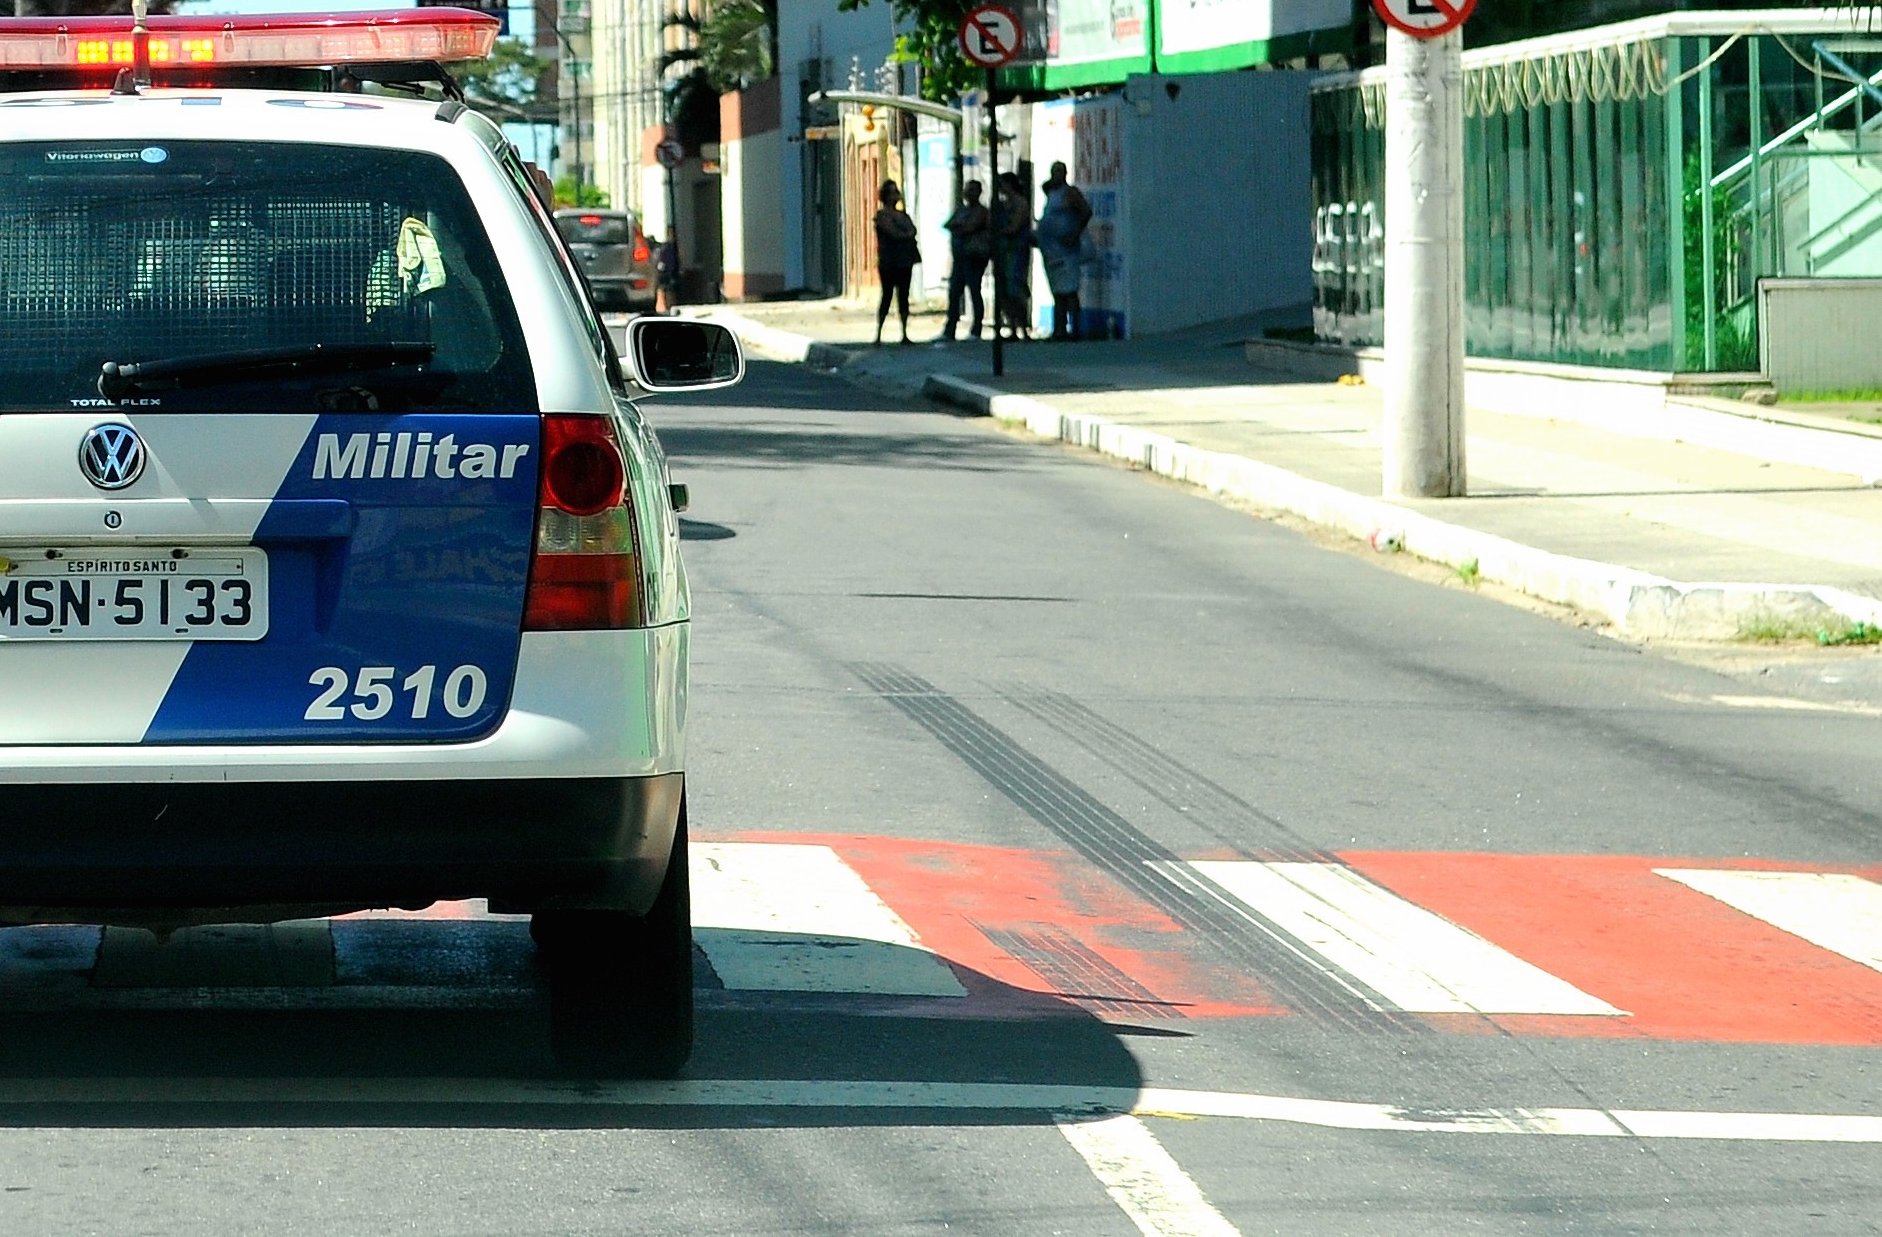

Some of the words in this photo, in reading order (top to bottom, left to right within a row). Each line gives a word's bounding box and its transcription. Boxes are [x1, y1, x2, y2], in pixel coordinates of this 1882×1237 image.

[70, 399, 116, 407] TOTAL
[120, 398, 161, 406] FLEX
[312, 432, 530, 480] Militar
[68, 558, 131, 573] ESPÍRITO
[133, 560, 178, 573] SANTO
[304, 664, 488, 721] 2510
